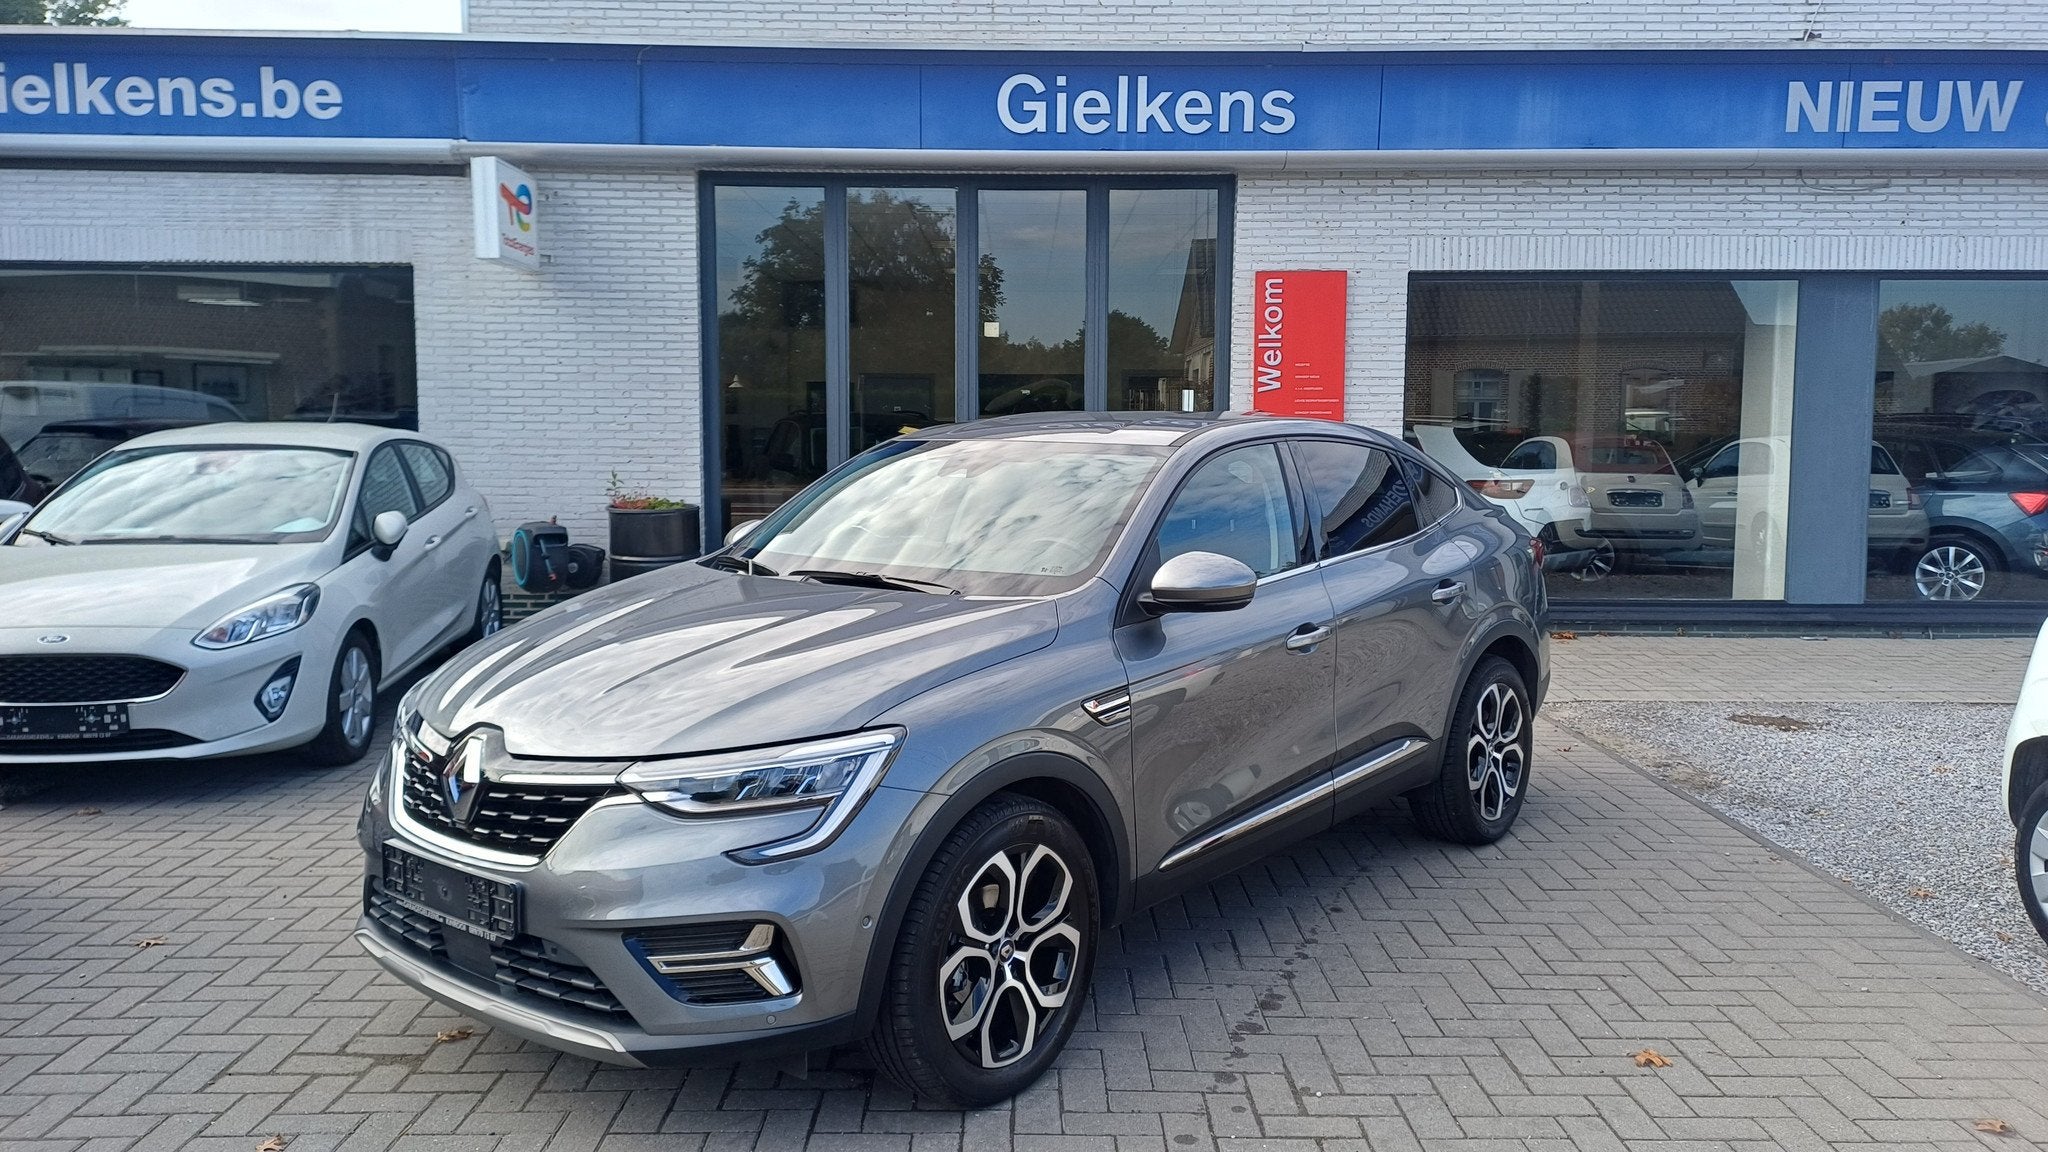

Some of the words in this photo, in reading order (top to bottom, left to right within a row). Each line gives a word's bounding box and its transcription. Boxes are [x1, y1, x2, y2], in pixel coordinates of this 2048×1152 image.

[997, 73, 1296, 134] Gielkens
[1785, 80, 2025, 133] NIEUW
[1257, 278, 1283, 393] Welkom
